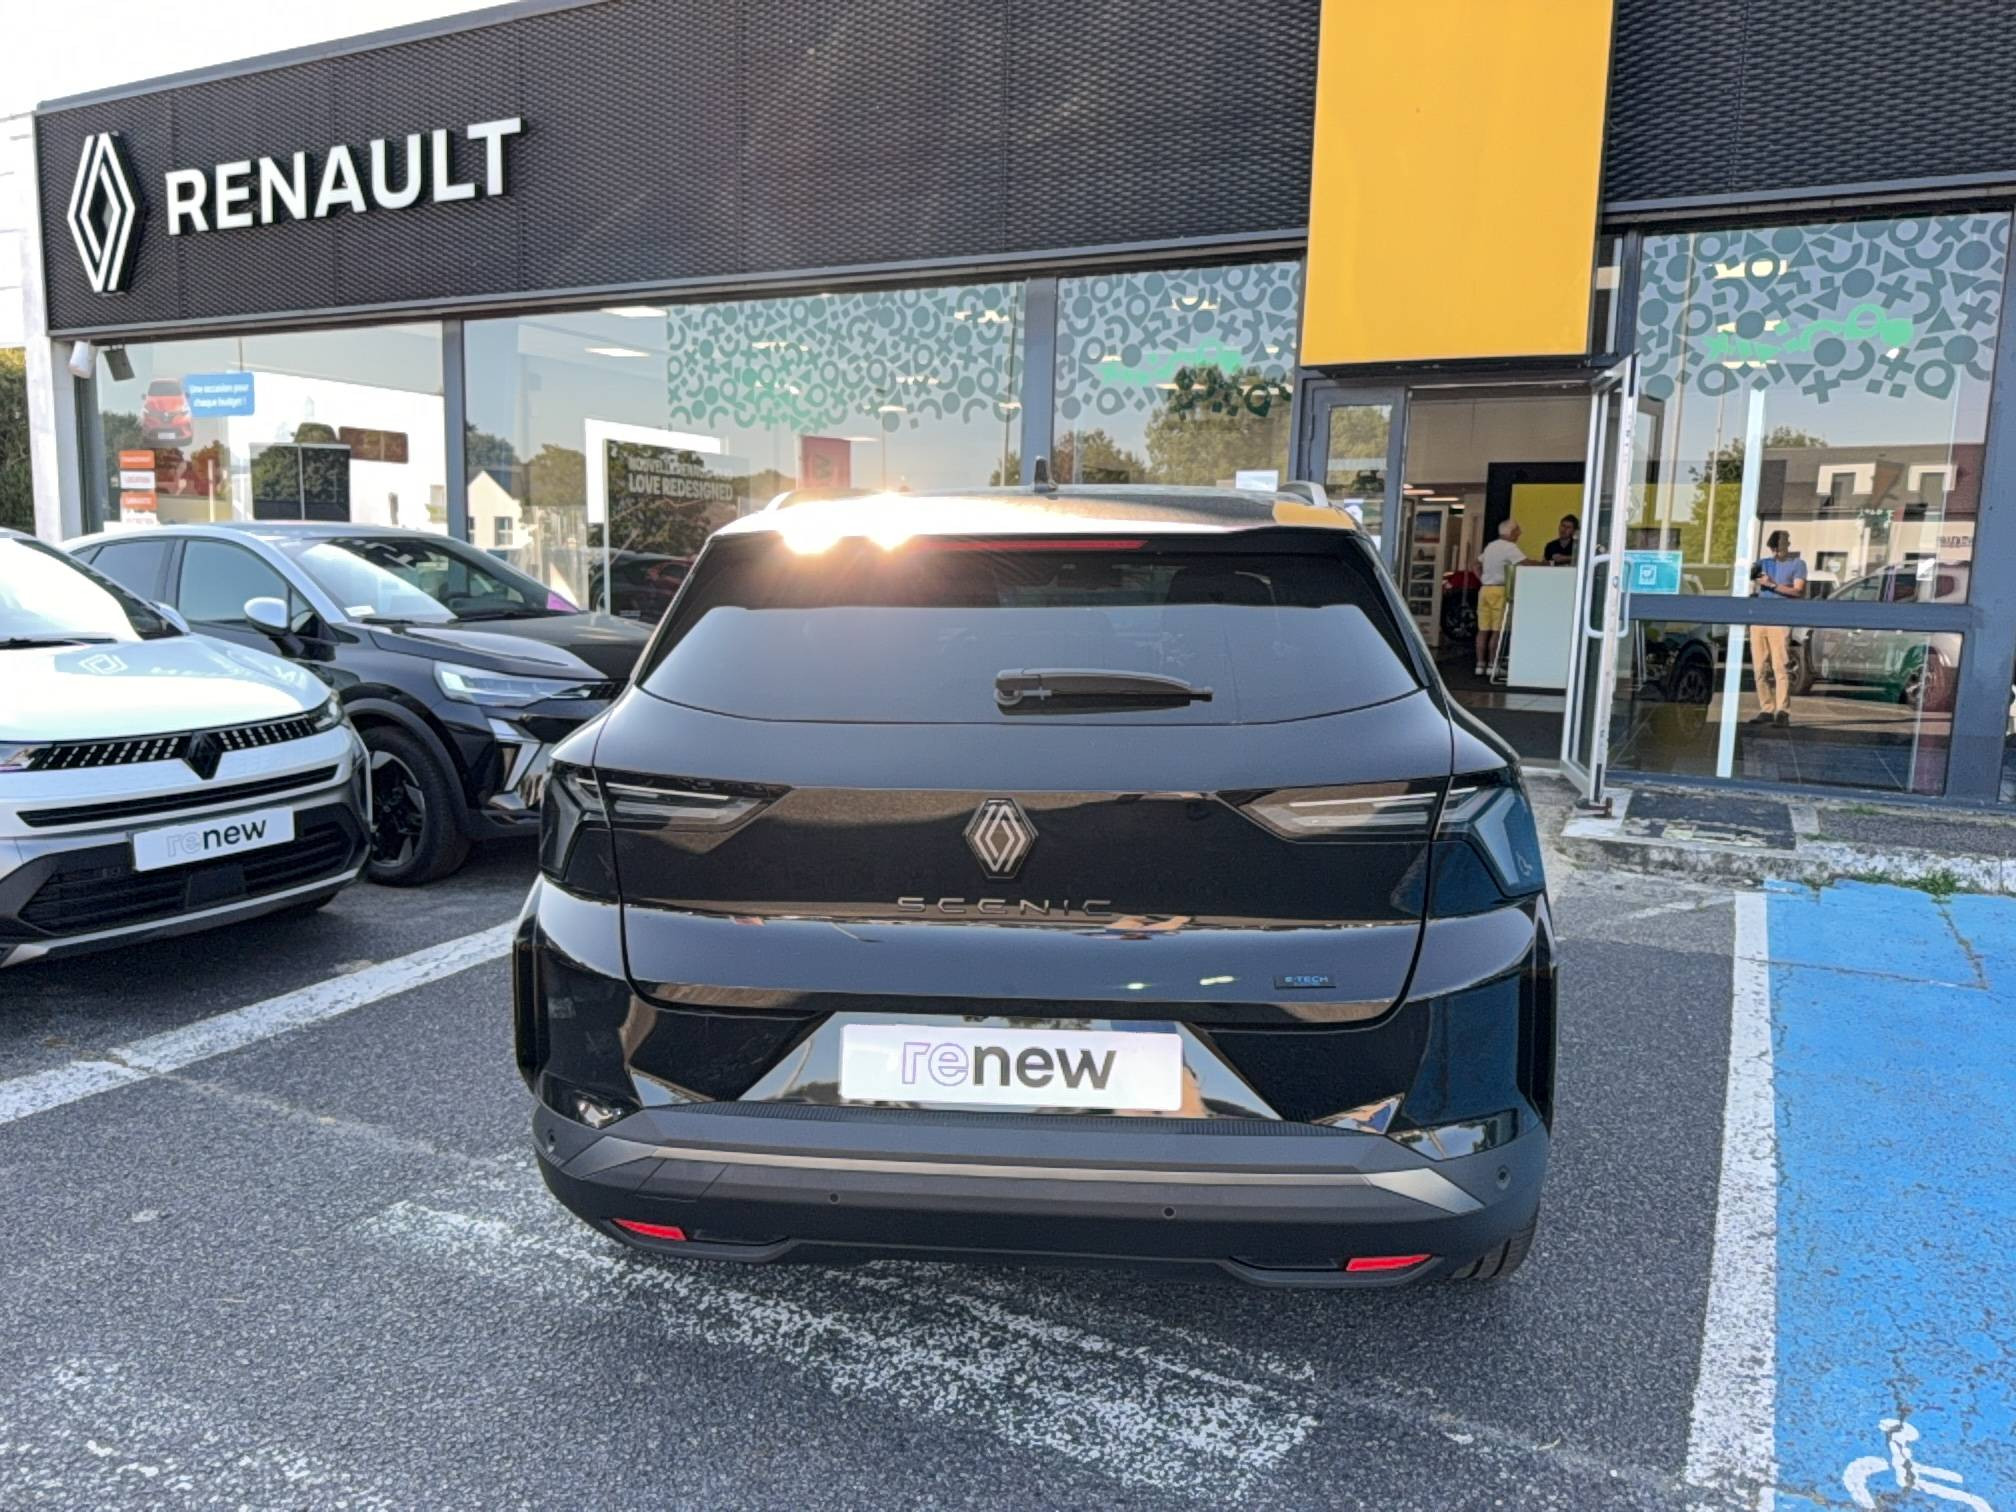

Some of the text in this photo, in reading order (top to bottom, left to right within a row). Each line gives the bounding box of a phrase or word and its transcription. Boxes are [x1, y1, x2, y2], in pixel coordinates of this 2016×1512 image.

[165, 117, 522, 235] RENAULT
[628, 473, 734, 501] LOVE REDESIGNED
[166, 819, 267, 858] renew
[897, 896, 1112, 917] SCENIC
[901, 1041, 1117, 1090] renew
